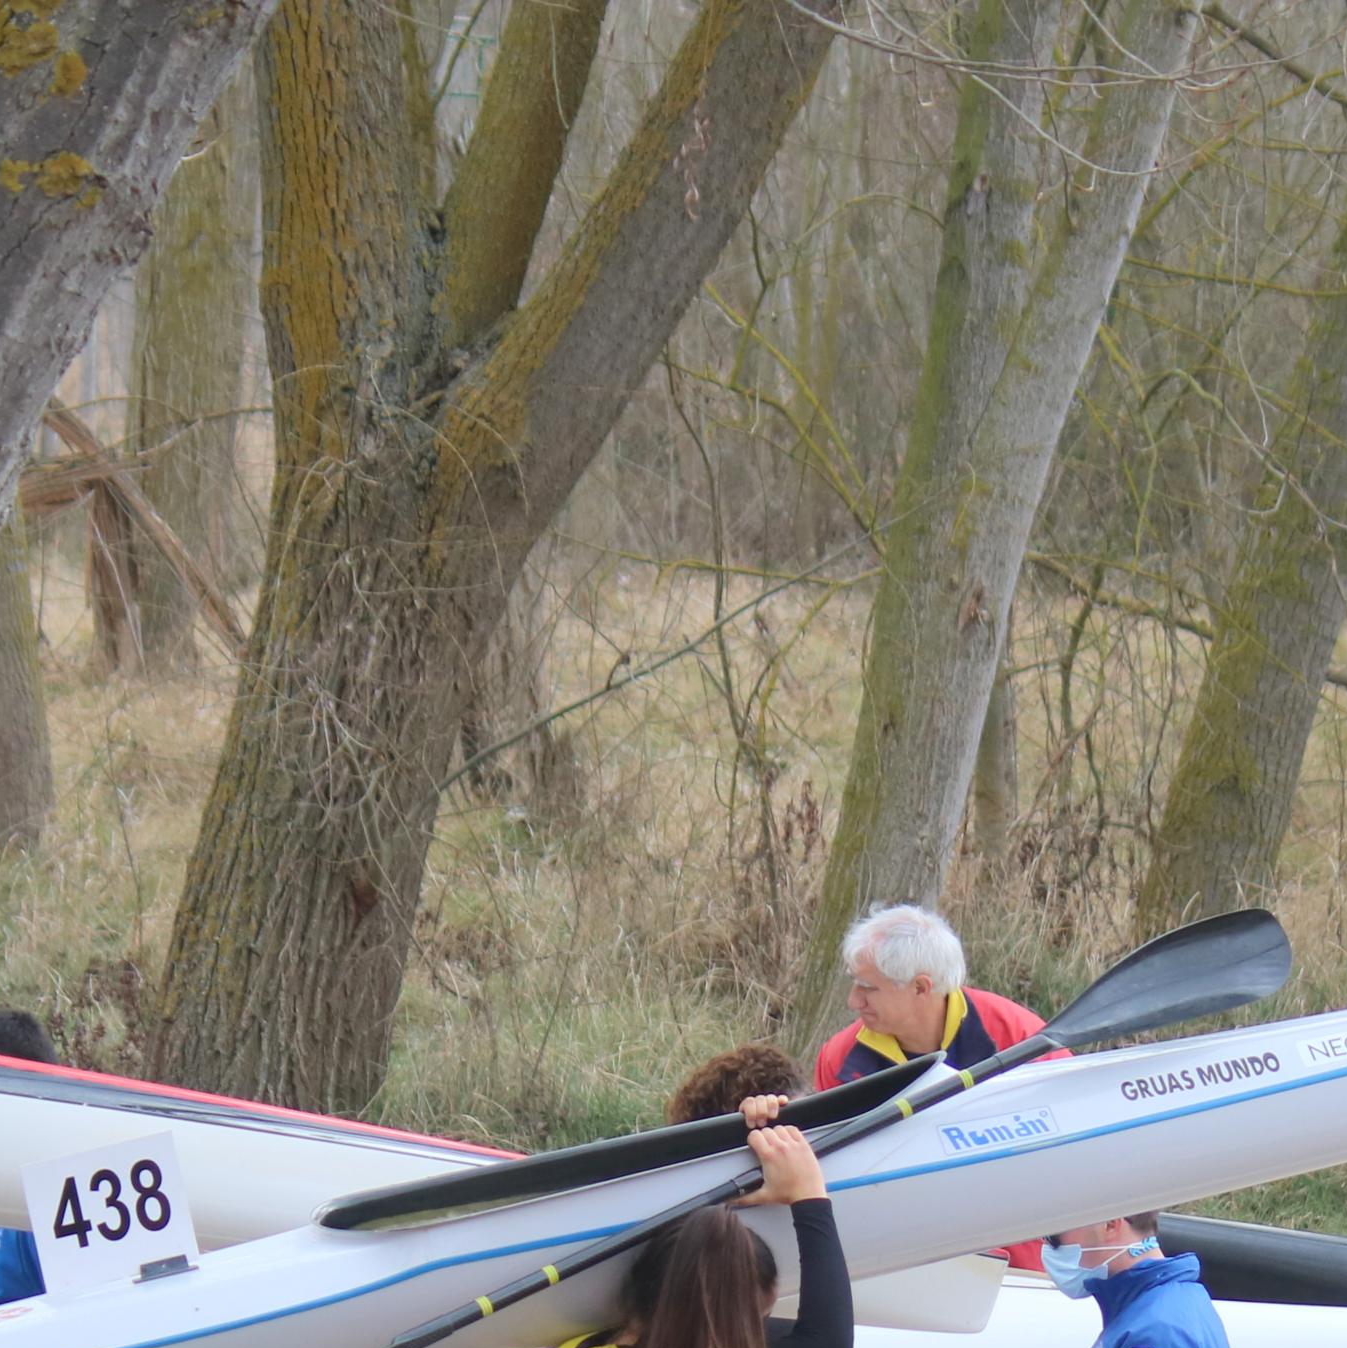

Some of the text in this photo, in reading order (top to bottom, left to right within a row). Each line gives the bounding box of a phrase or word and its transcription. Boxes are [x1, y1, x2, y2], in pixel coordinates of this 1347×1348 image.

[1120, 1052, 1281, 1101] GRUAS MUNDO
[53, 1159, 171, 1248] 438
